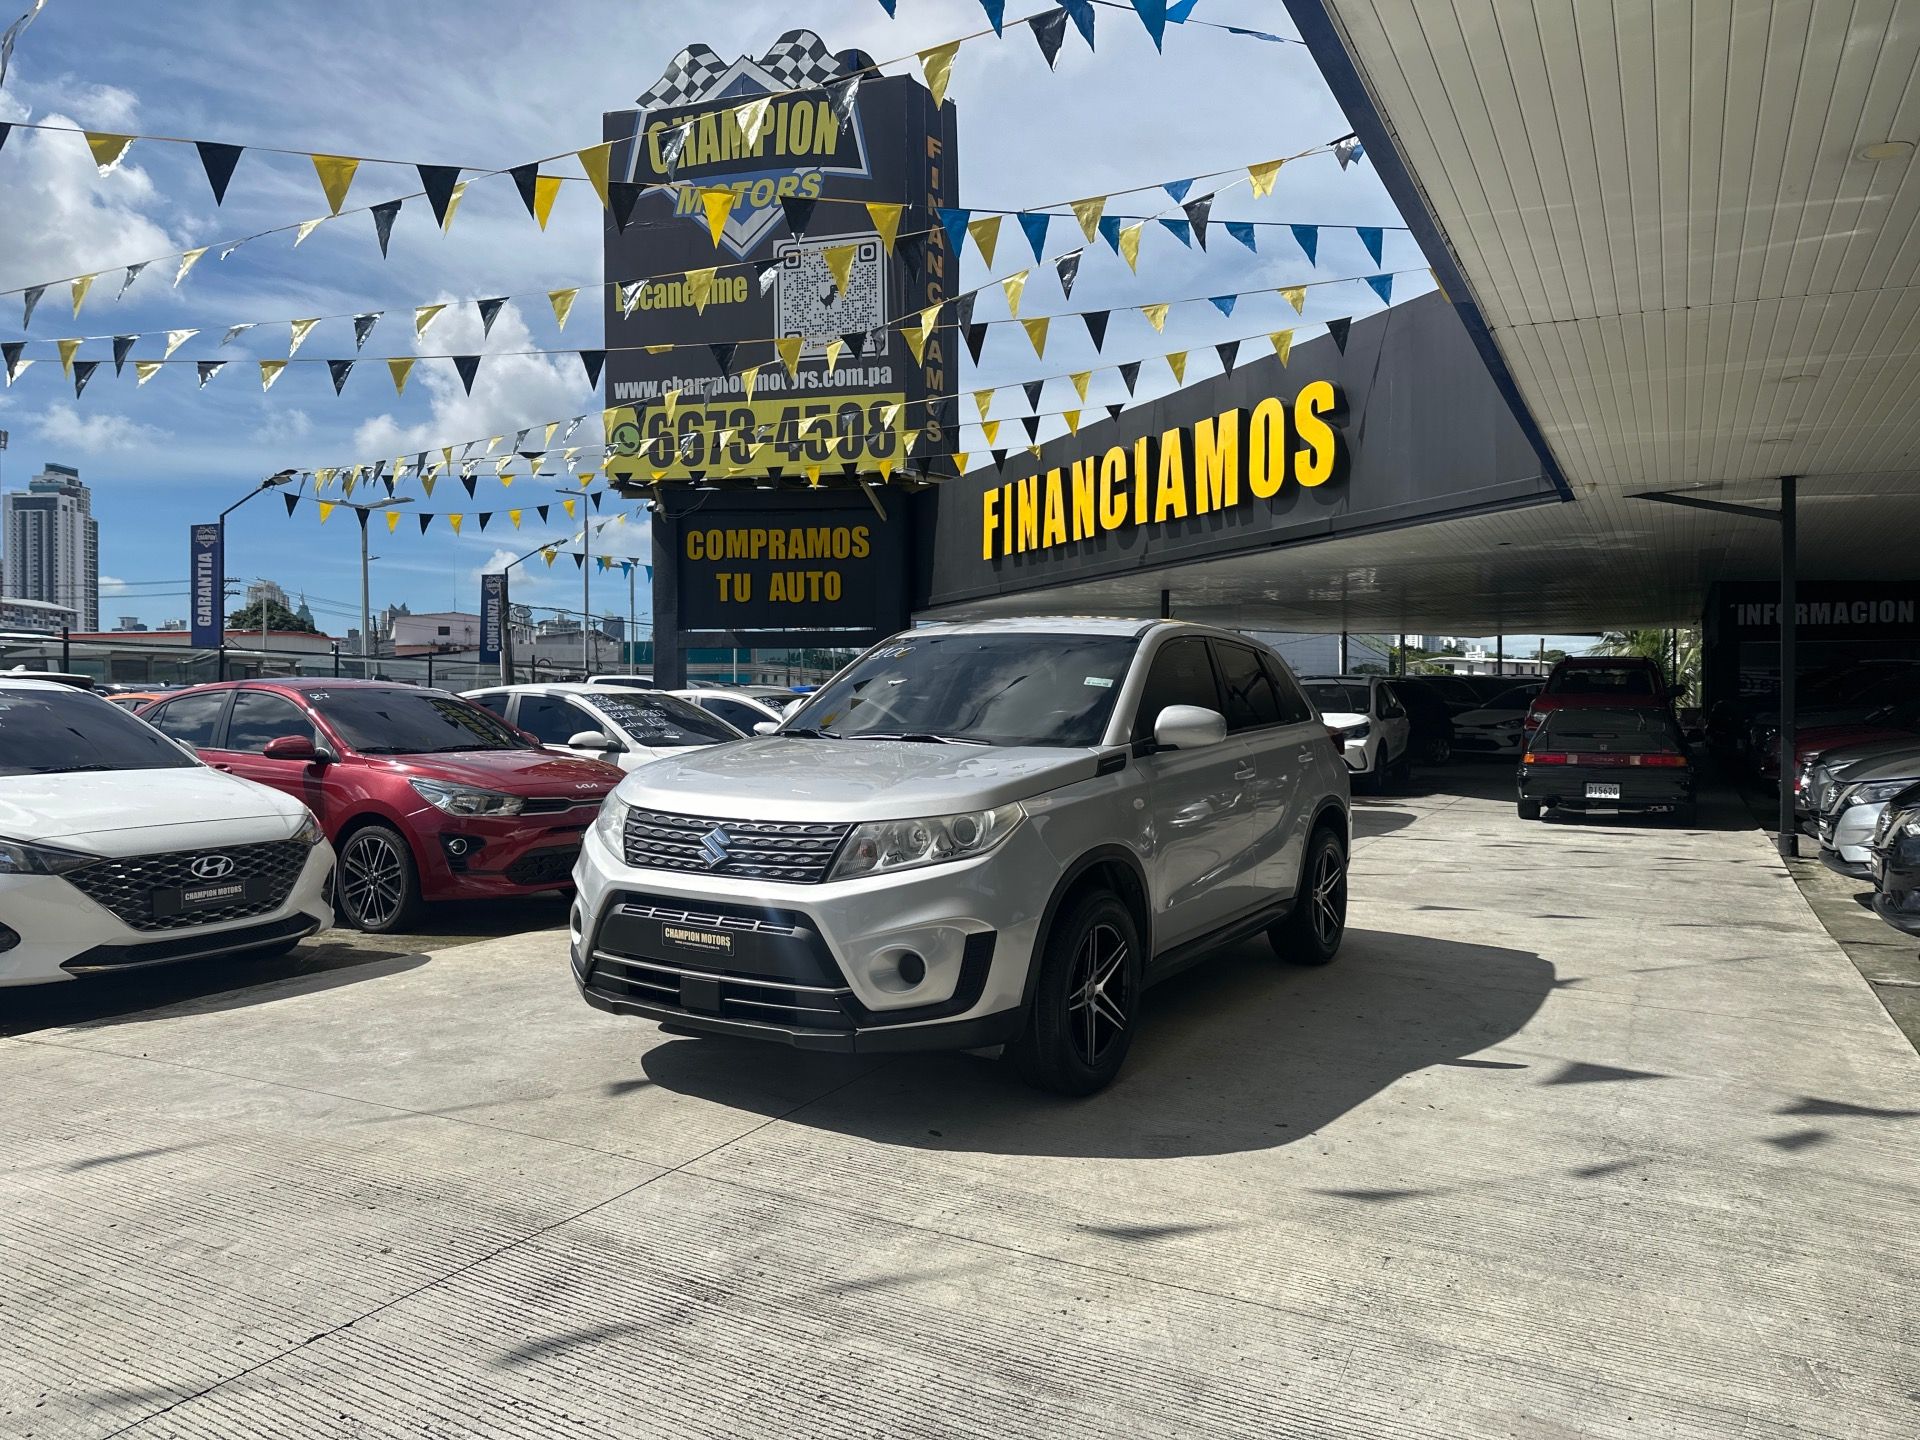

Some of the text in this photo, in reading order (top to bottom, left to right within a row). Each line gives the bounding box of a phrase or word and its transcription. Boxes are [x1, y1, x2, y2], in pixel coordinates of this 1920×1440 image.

[647, 400, 898, 468] 6673-4508
[983, 380, 1335, 561] FINANCIAMOS
[686, 526, 870, 561] COMPRAMOS
[197, 552, 212, 627] GARANTIA
[716, 571, 842, 603] TU AUTO
[486, 598, 499, 652] CONFIANZA
[185, 889, 217, 901] CHAMPION
[217, 885, 243, 896] MOTORS
[665, 927, 700, 942] CHAMPION
[701, 933, 731, 948] MOTORS
